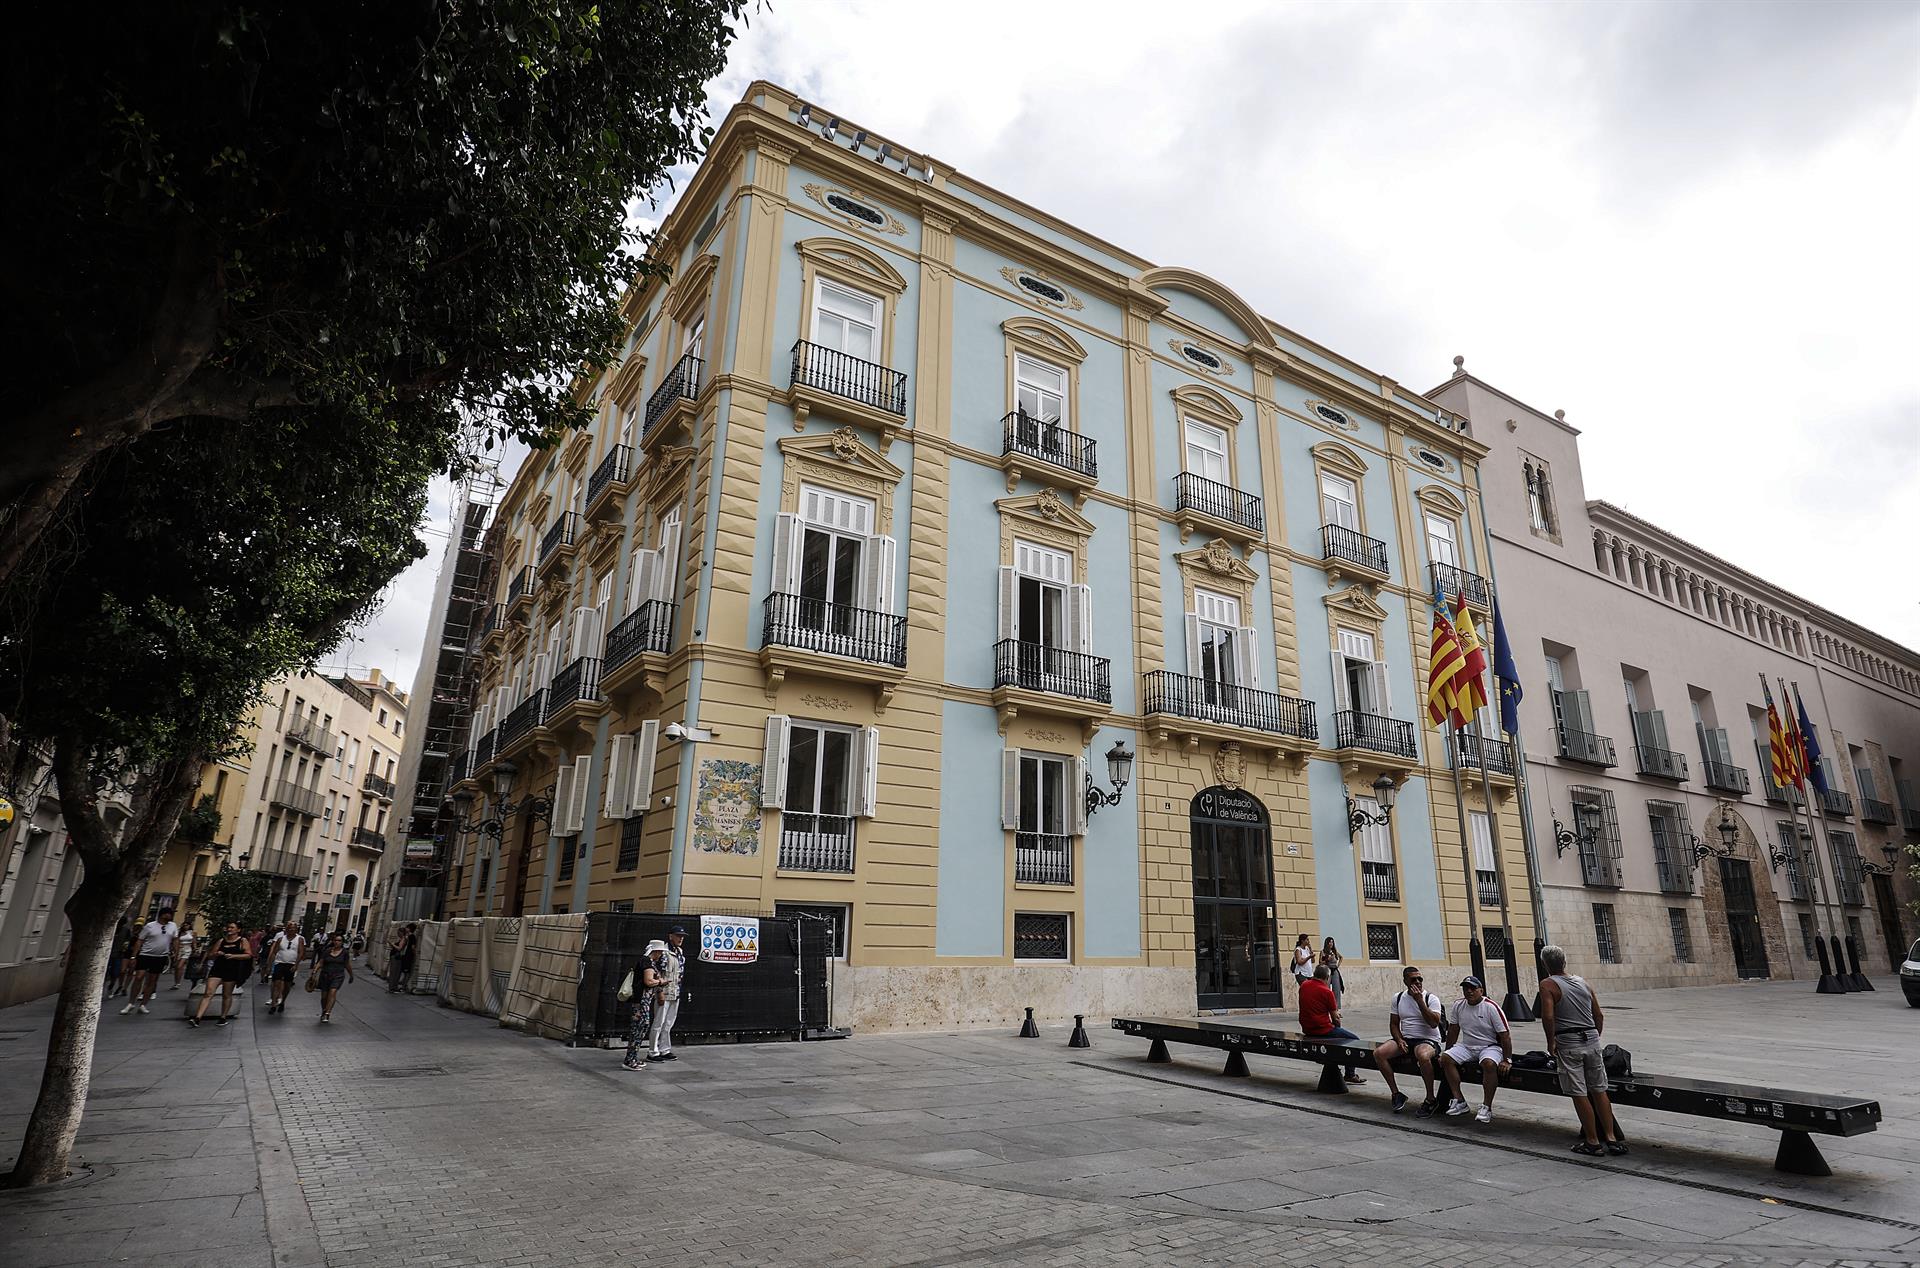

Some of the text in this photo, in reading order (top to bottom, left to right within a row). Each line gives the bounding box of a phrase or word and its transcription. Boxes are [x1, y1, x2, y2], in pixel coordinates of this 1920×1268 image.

[1219, 795, 1252, 808] Diputació
[1219, 808, 1258, 821] de València
